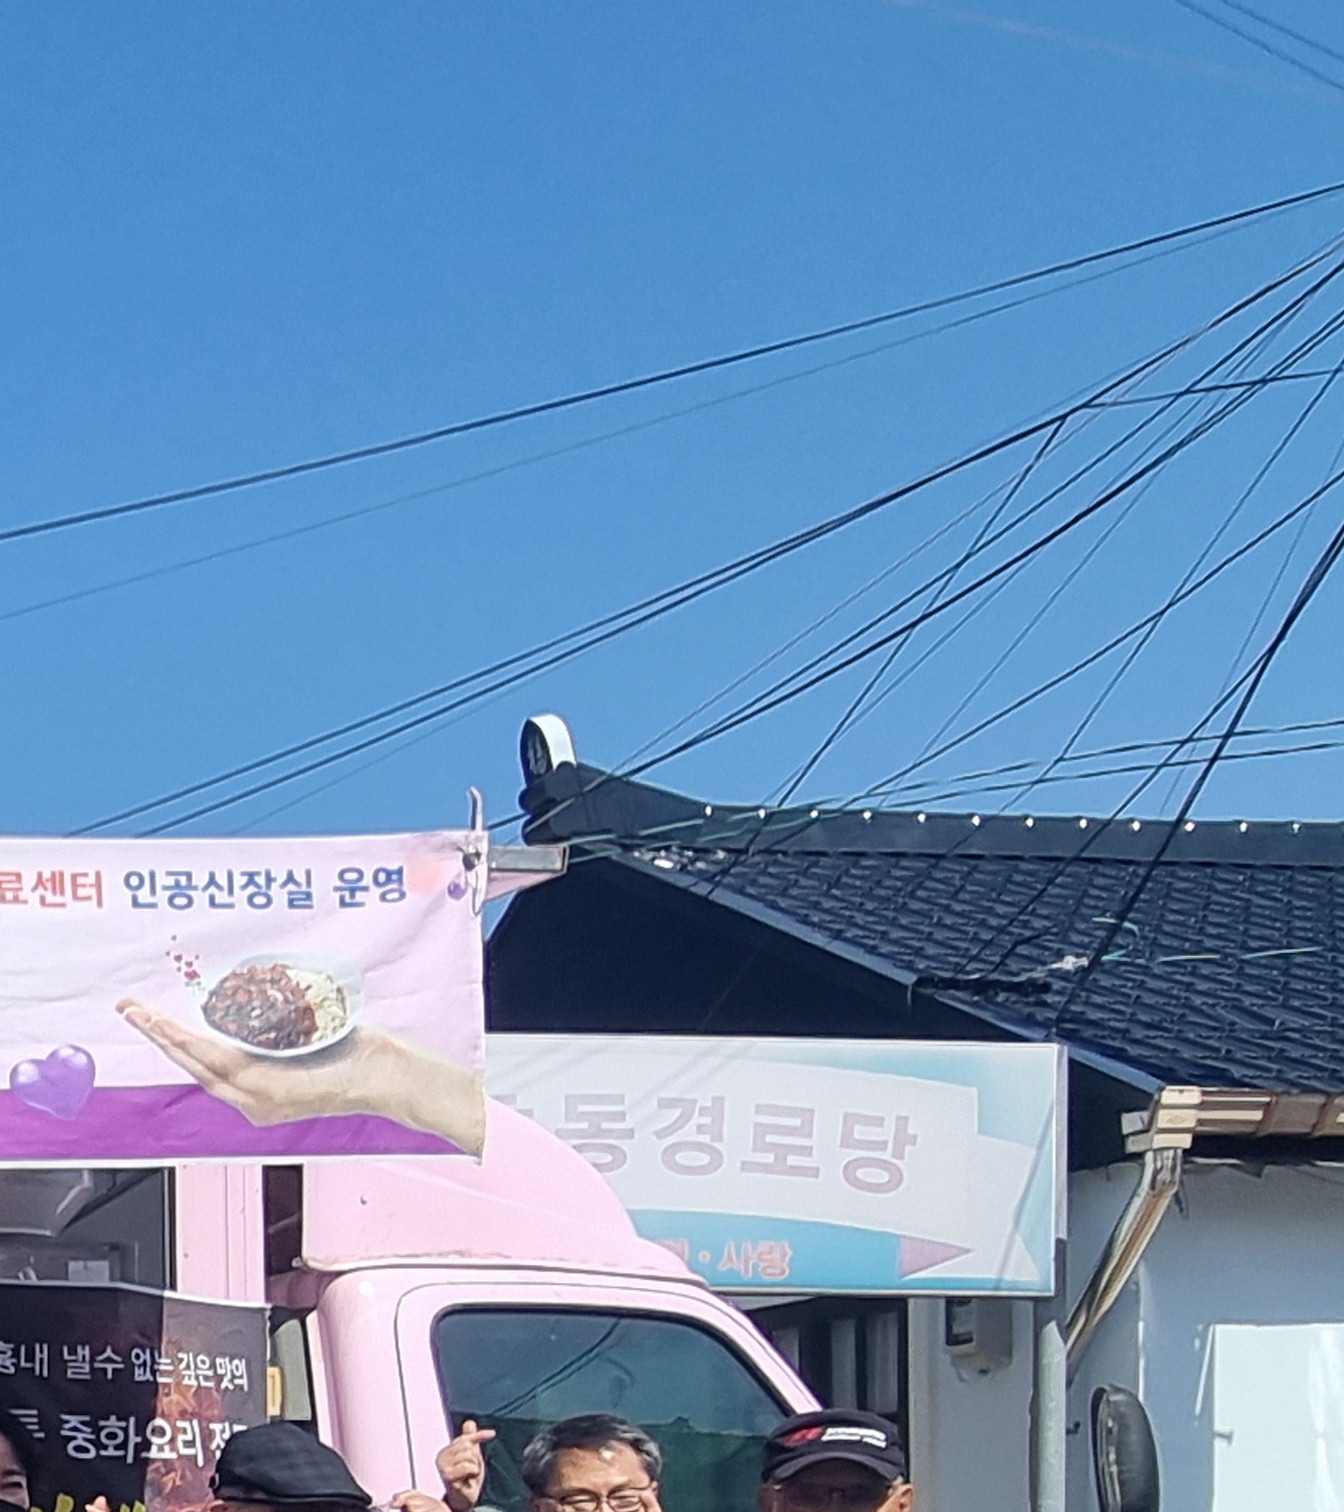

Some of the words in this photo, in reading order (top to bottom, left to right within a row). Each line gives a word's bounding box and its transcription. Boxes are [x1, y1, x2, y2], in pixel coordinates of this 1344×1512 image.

[121, 866, 315, 910] 인공신장실
[332, 864, 408, 906] 운영
[492, 1092, 918, 1195] 동경로당
[62, 1344, 125, 1380] 낼수
[130, 1347, 174, 1383] 없는
[177, 1351, 214, 1388] 깊은
[215, 1356, 248, 1392] 맛의
[60, 1414, 204, 1468] 중화요리
